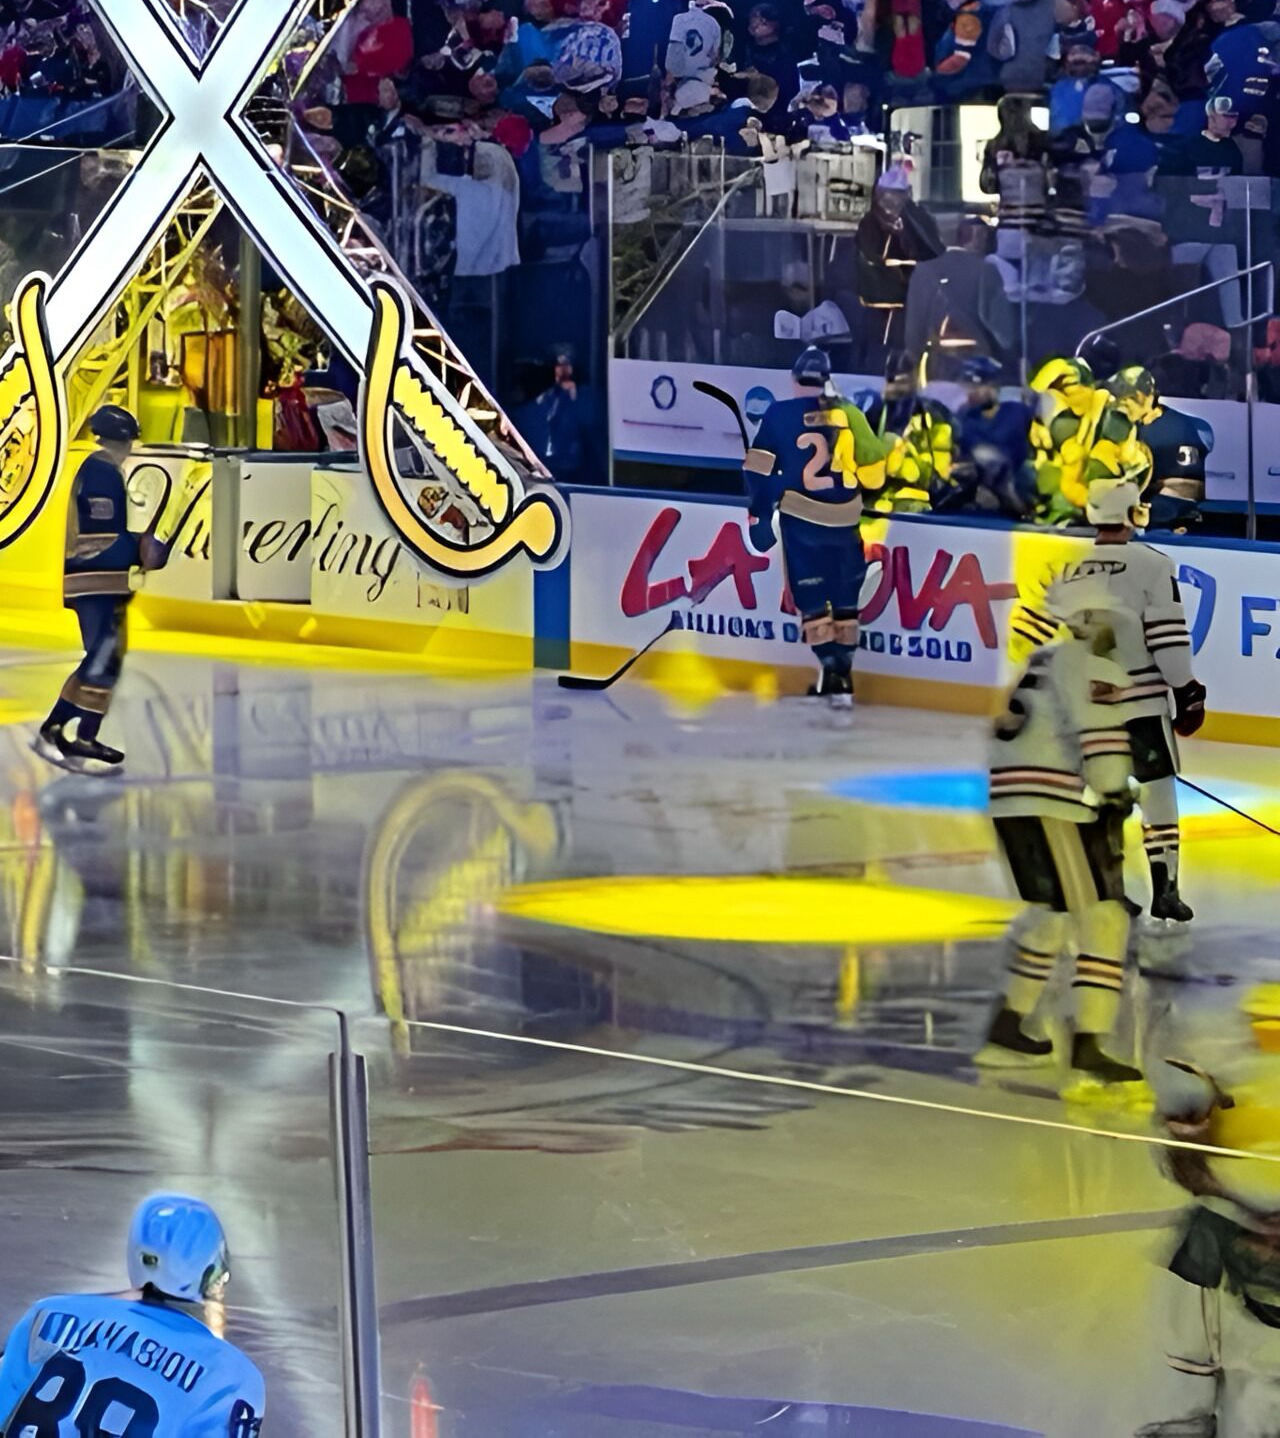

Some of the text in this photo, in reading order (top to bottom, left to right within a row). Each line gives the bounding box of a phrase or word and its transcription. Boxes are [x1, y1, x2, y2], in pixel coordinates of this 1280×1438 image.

[621, 506, 1018, 650] LA OVA
[907, 635, 972, 663] SOLD
